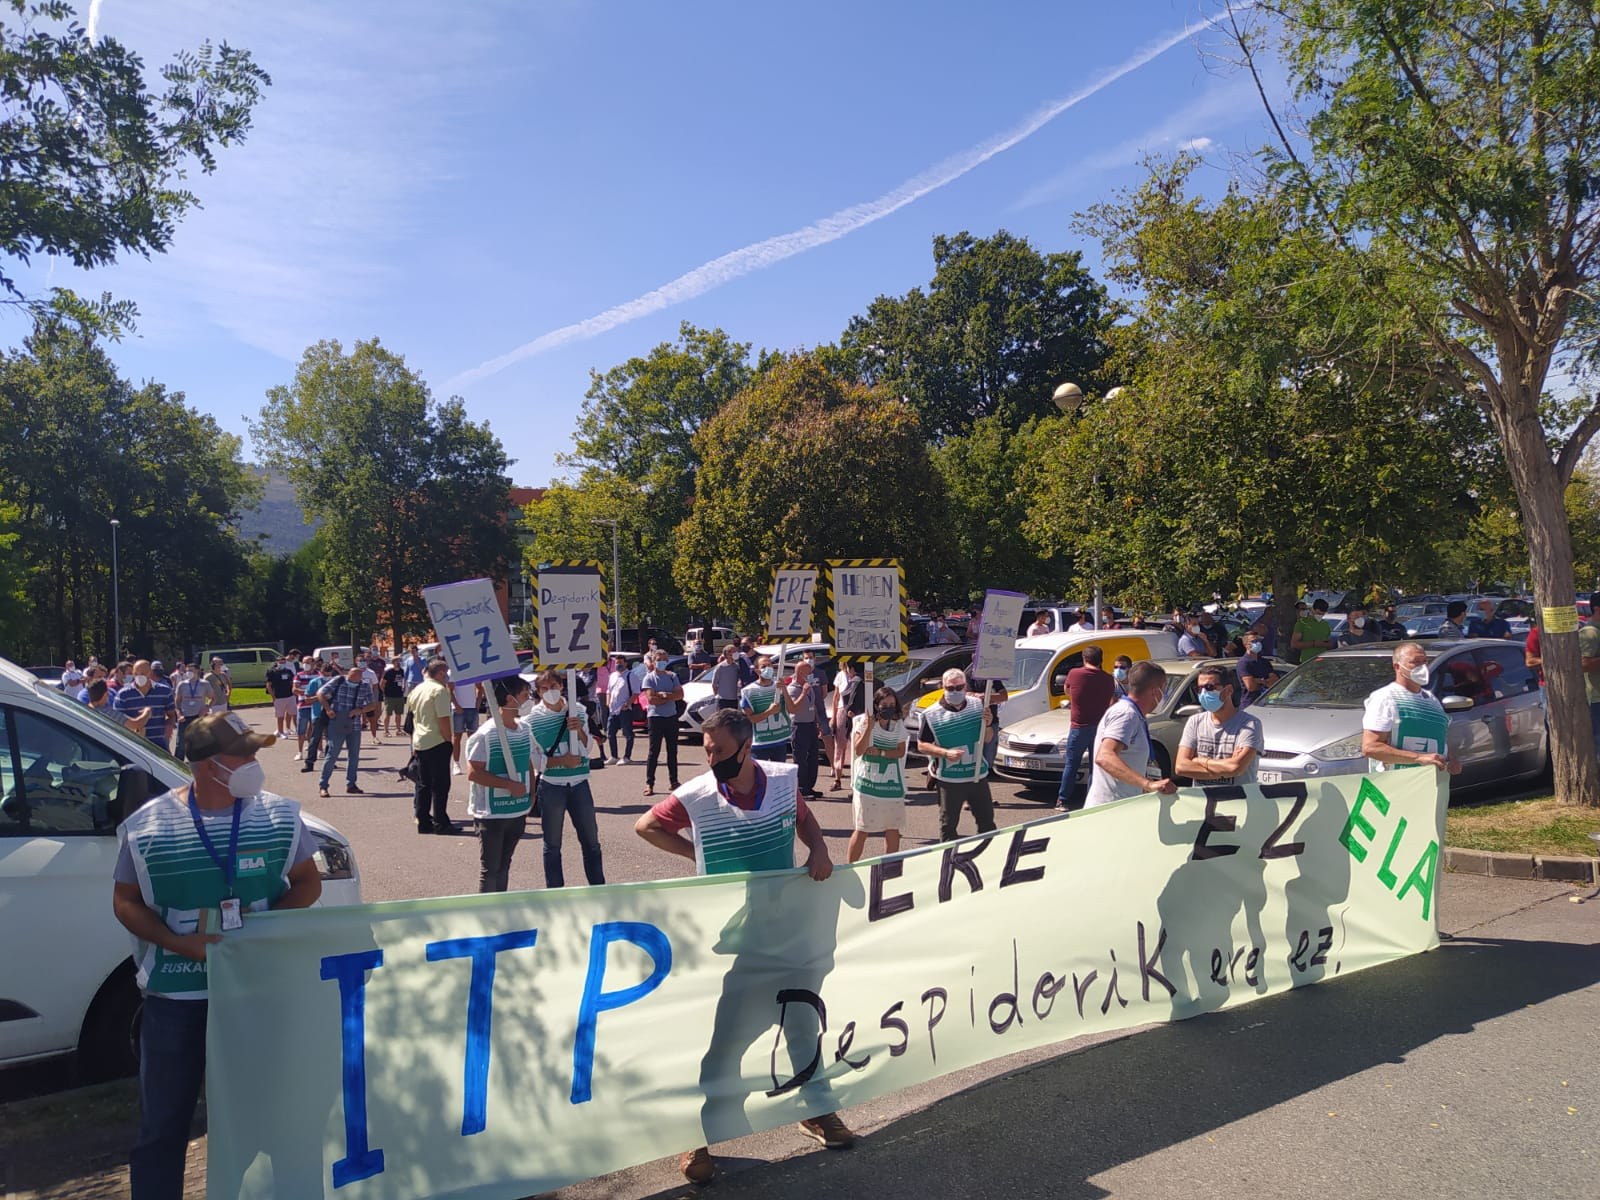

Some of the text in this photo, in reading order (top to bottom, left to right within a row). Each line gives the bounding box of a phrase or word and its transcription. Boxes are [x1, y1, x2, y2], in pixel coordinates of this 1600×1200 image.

[775, 576, 813, 605] ERE
[842, 574, 893, 598] HEMEN
[543, 613, 590, 653] EZ
[776, 609, 802, 631] EZ
[444, 626, 500, 671] EZ
[239, 857, 266, 870] ELA
[1338, 776, 1440, 922] ELA
[320, 781, 1309, 1189] ITP ERE EZ
[1210, 947, 1260, 987] ere
